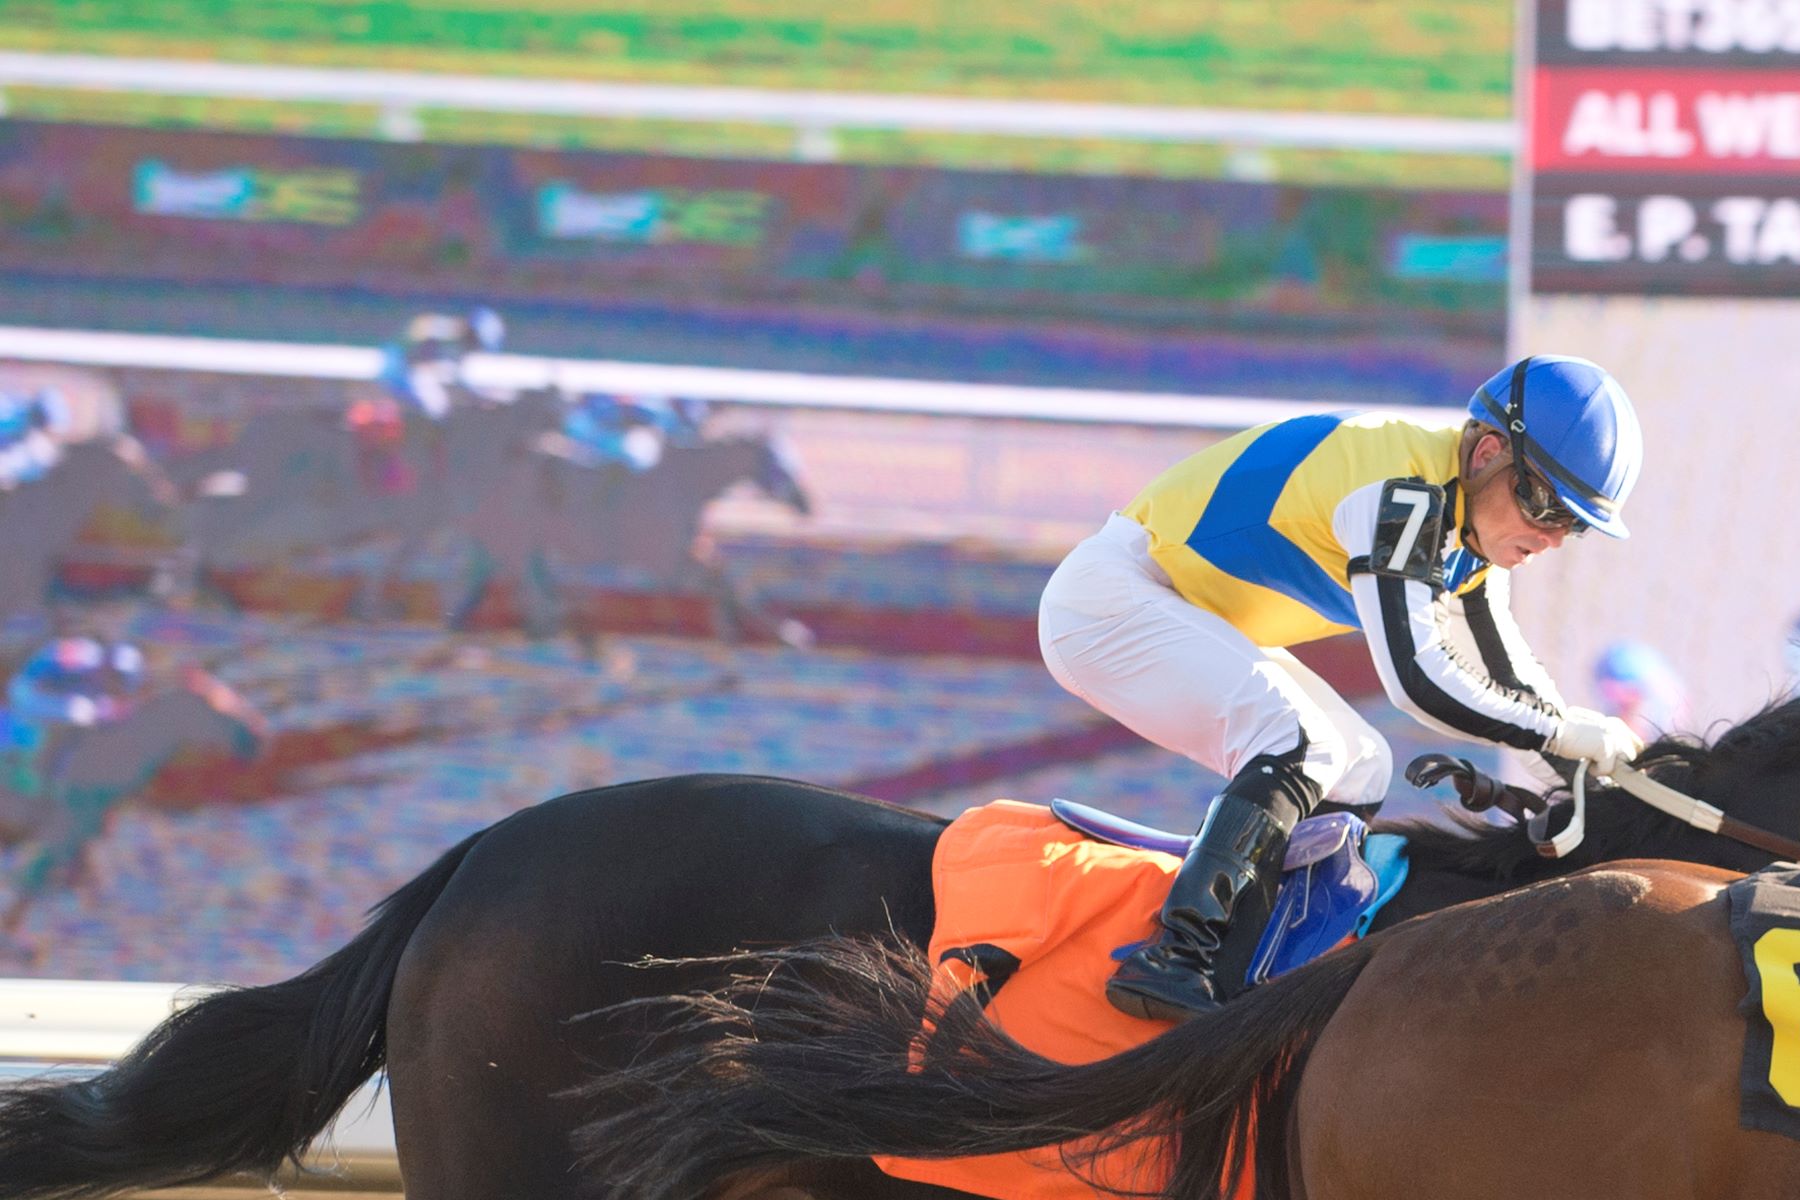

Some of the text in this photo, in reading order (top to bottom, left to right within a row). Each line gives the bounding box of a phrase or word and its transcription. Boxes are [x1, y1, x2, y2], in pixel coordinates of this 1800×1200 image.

[1562, 90, 1694, 157] ALL
[1564, 194, 1632, 262] E.
[1636, 195, 1710, 262] P.
[1387, 488, 1430, 571] 7
